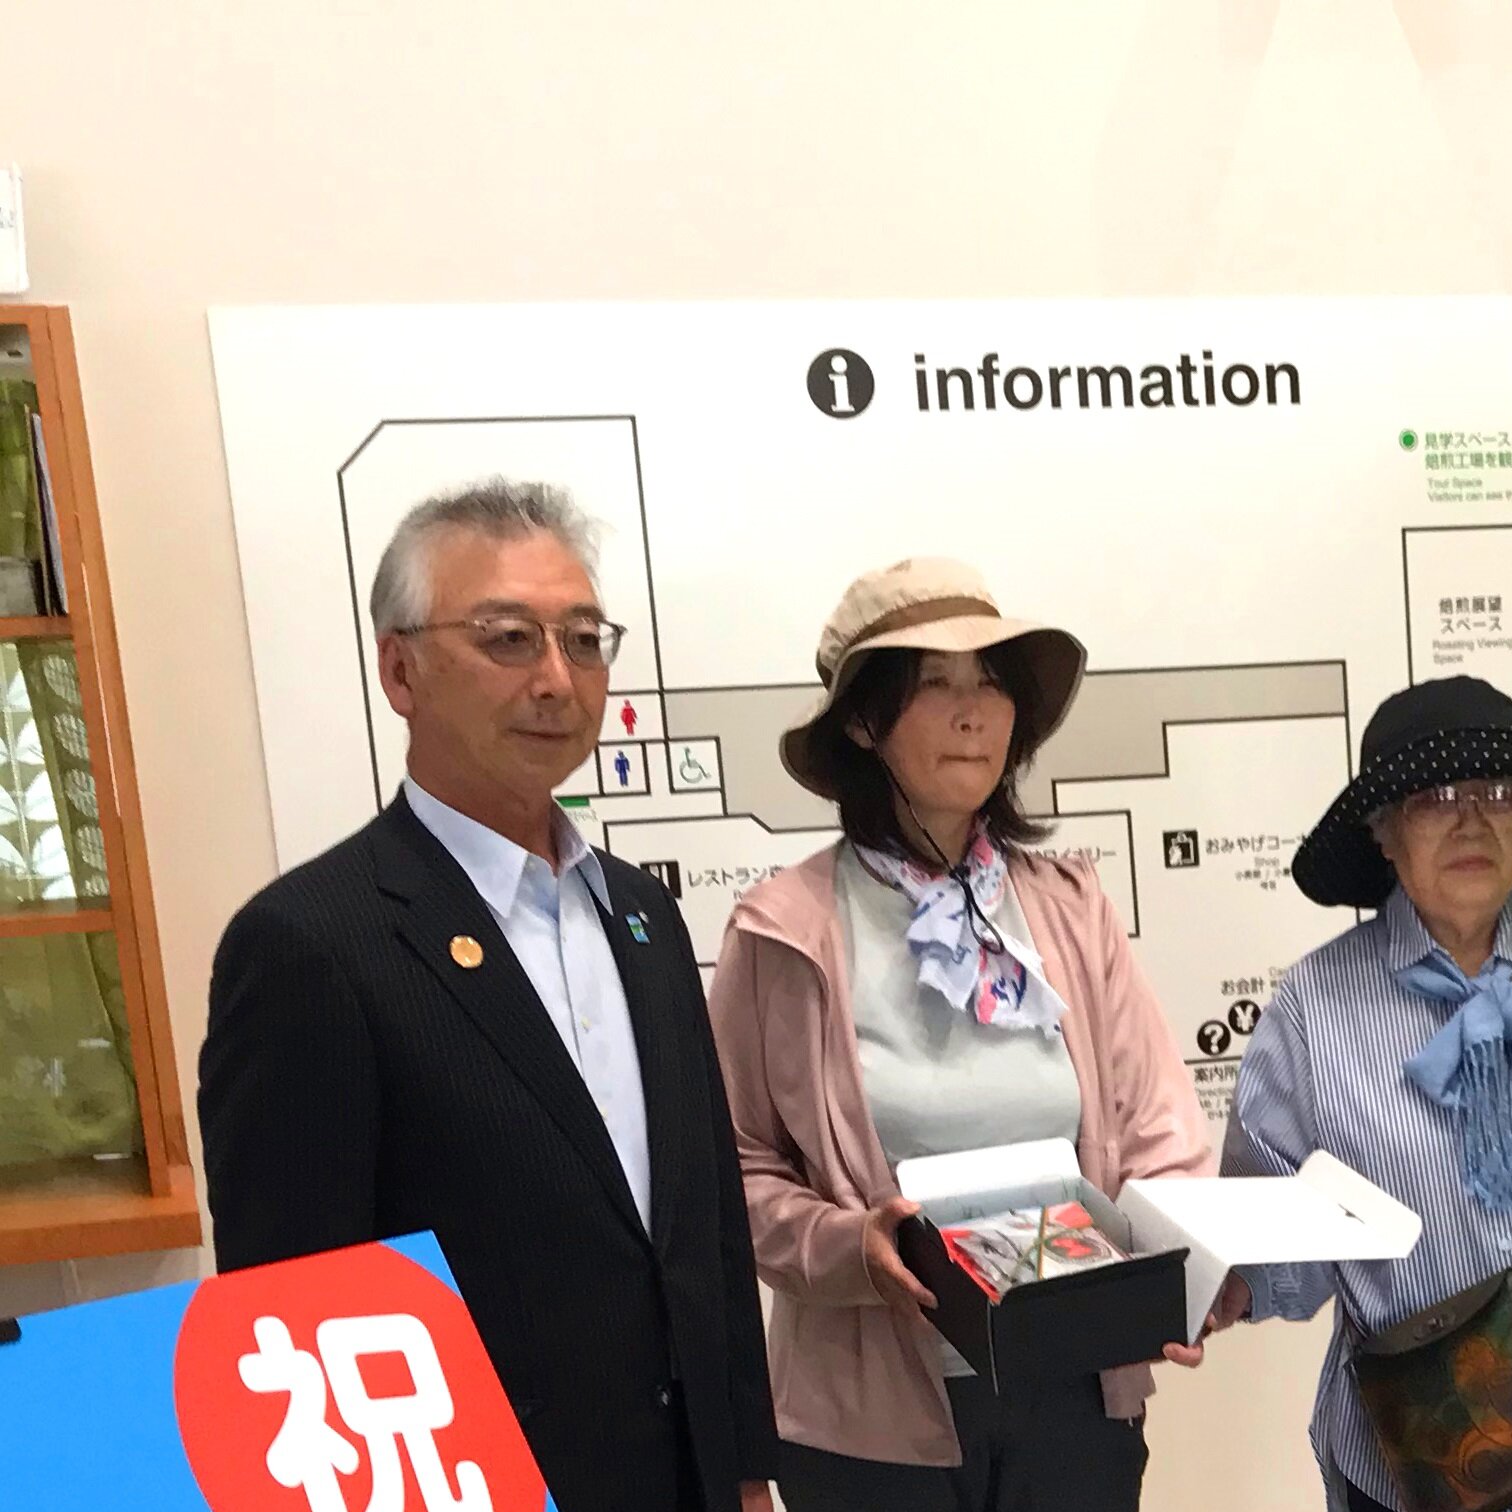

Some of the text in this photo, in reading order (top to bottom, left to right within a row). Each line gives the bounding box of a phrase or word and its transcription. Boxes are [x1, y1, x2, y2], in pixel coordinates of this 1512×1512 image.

[913, 350, 1301, 412] information
[1425, 432, 1512, 450] 見学スペース
[1452, 478, 1483, 491] Space
[1440, 617, 1502, 634] スペース
[1432, 639, 1475, 652] Roasting
[1433, 653, 1464, 666] Space
[1220, 977, 1265, 996] お会計
